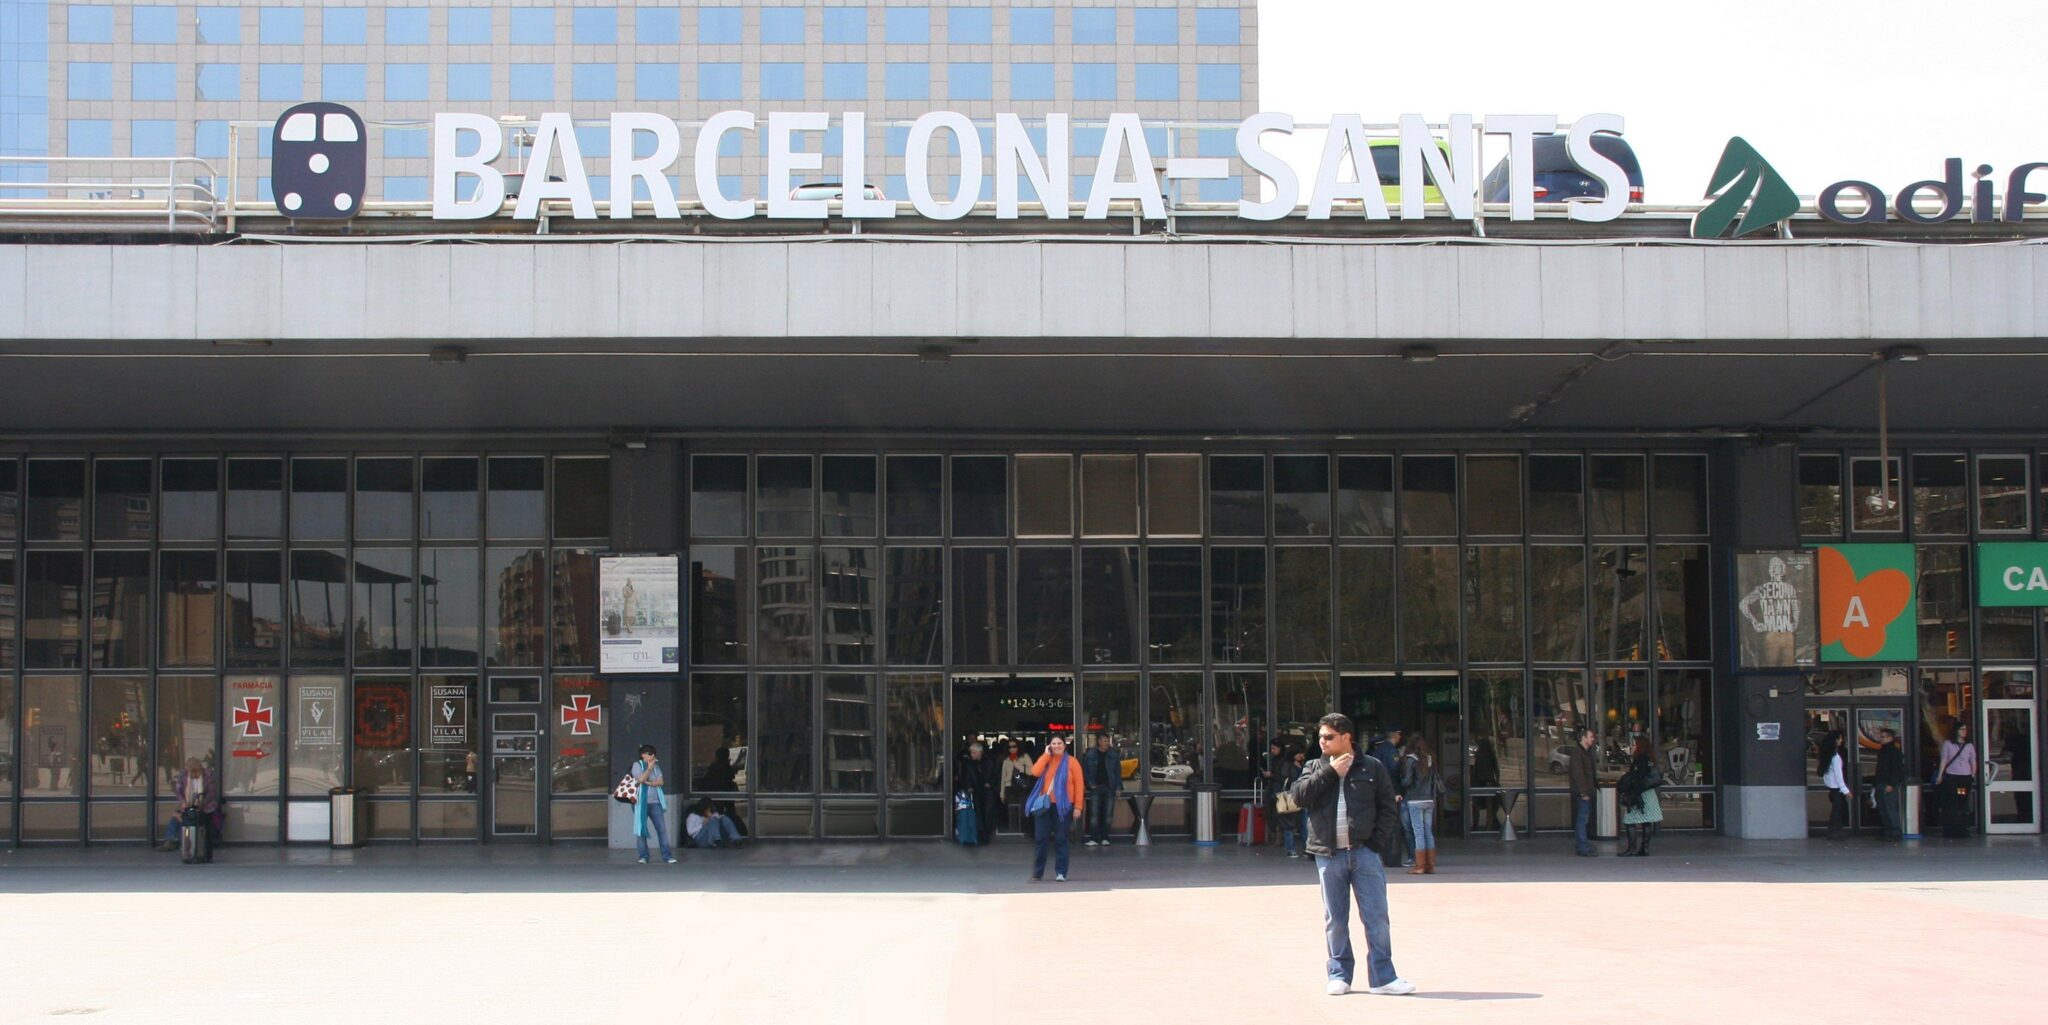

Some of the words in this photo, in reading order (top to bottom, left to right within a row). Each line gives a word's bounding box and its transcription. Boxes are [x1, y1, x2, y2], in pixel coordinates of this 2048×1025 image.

[432, 110, 1630, 222] BARCELONA-SANTS
[1814, 157, 2048, 224] adif
[2003, 566, 2048, 591] CA
[1842, 596, 1869, 627] A
[301, 689, 333, 697] SUSANA
[433, 688, 465, 696] SUSANA
